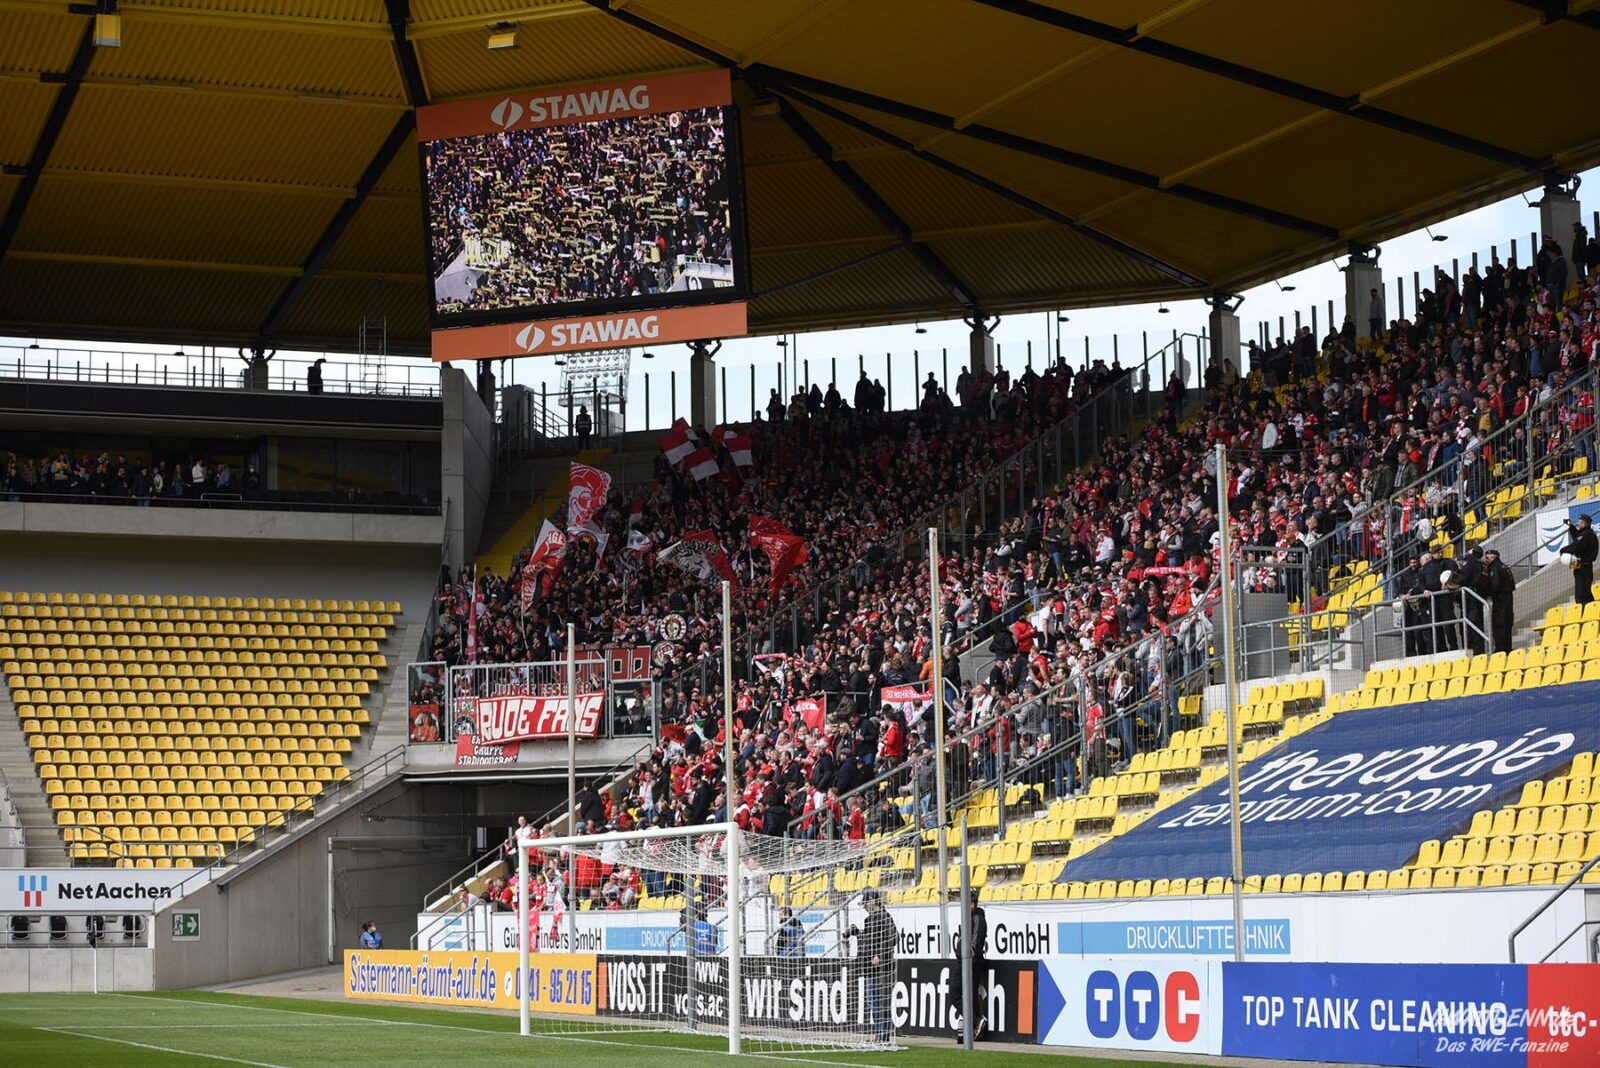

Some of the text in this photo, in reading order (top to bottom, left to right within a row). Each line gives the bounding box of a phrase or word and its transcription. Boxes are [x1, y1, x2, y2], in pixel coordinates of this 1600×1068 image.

[529, 84, 650, 122] STAWAG
[551, 315, 659, 347] STAWAG
[479, 699, 535, 742] RUDE
[537, 695, 605, 734] FANS
[1218, 727, 1575, 796] therapie
[58, 882, 172, 900] NetAachen
[995, 923, 1050, 954] GmbH
[1127, 924, 1286, 950] DRUCKLUFTTEHNIK
[350, 953, 498, 1002] Sistermann-räumt-auf.de
[515, 967, 540, 1001] 041
[550, 968, 563, 1003] 95
[566, 969, 578, 1004] 21
[581, 969, 592, 1006] 15
[608, 961, 666, 1013] VOSS IT
[745, 966, 782, 1019] wir
[789, 966, 848, 1024] sind
[1086, 970, 1200, 1042] TTC
[1242, 995, 1507, 1037] TOP TANK CLEANING
